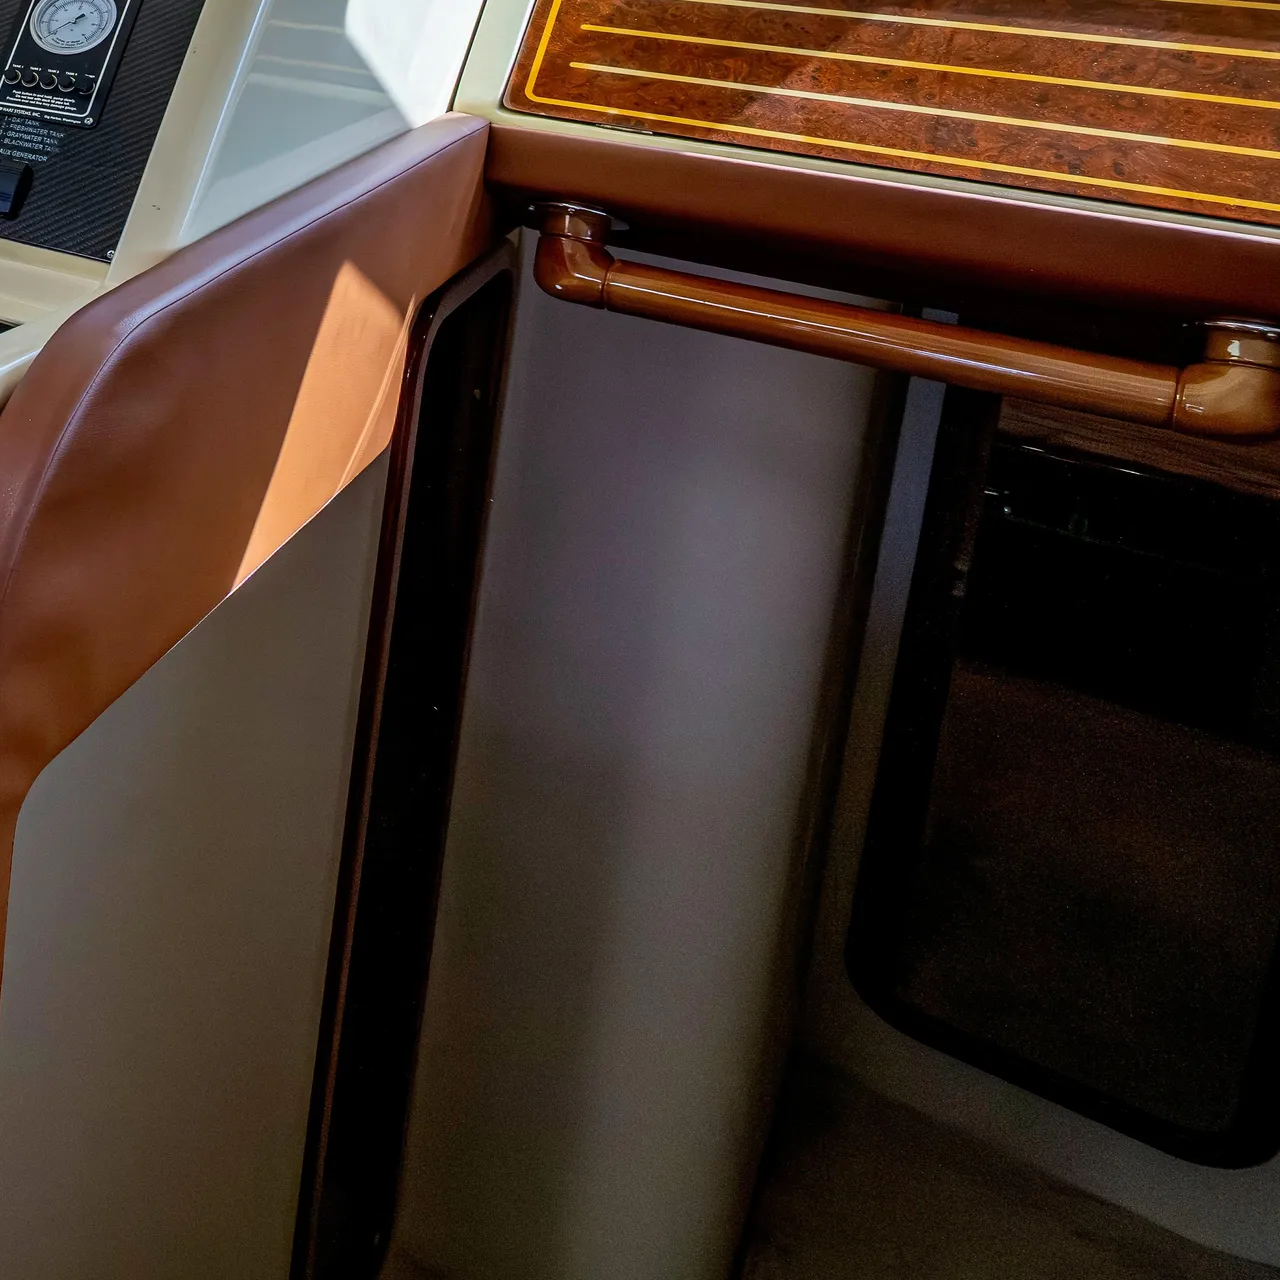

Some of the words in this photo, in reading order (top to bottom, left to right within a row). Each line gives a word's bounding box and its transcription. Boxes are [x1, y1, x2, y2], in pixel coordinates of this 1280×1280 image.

[24, 118, 40, 127] TANK
[6, 130, 42, 142] GRAYWATER
[43, 137, 59, 145] TANK
[9, 124, 49, 136] FRESHWATER
[49, 130, 66, 138] TANK
[3, 137, 43, 150] BLACKWATER
[11, 150, 48, 162] GENERATOR
